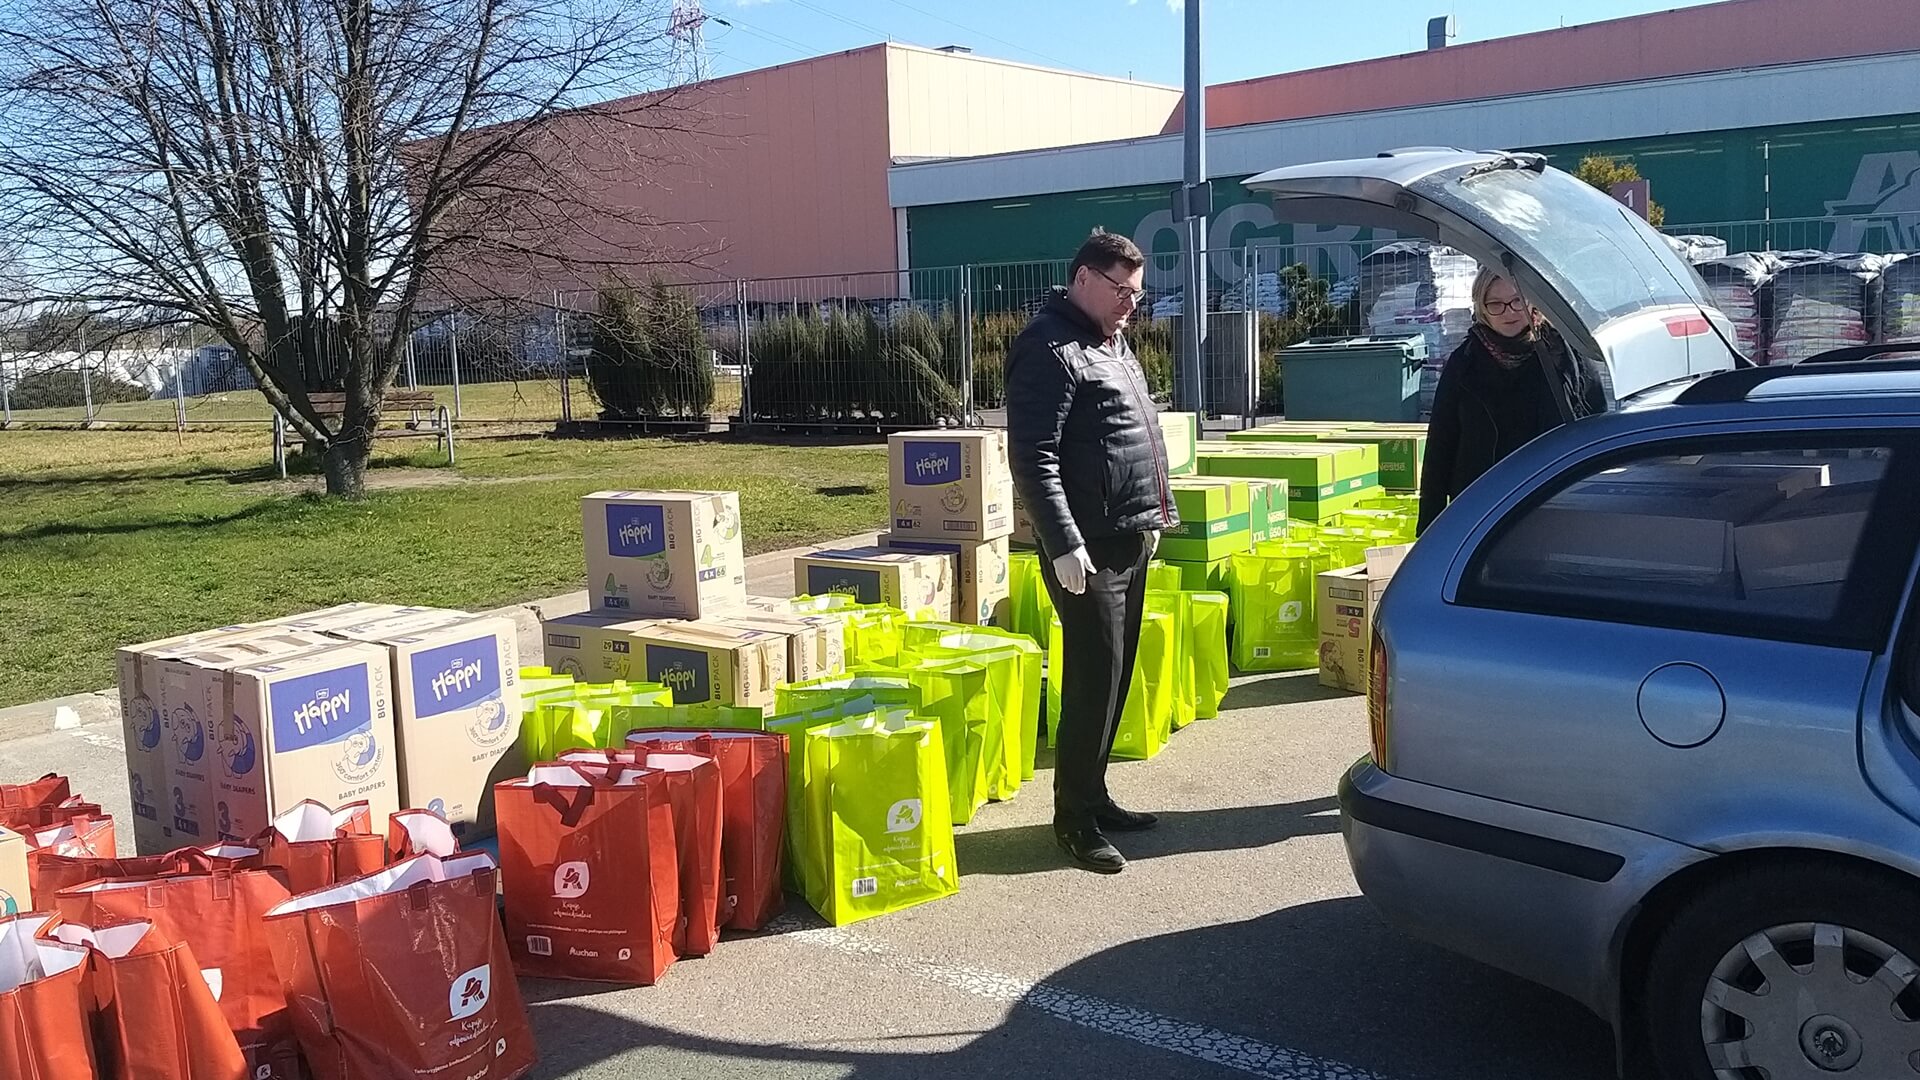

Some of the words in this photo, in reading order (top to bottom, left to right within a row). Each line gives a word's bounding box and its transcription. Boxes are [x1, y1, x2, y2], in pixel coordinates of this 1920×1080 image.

[1623, 188, 1634, 208] 1
[1133, 203, 1398, 291] OGR
[666, 507, 674, 533] PACK
[669, 534, 677, 550] BIG
[700, 543, 714, 568] 4
[605, 572, 619, 596] 4
[1347, 617, 1361, 638] 5
[502, 636, 511, 668] PACK
[712, 655, 720, 683] PACK
[374, 665, 385, 699] PACK
[713, 683, 721, 700] BIG
[377, 698, 386, 720] BIG
[208, 720, 216, 741] BIG
[471, 752, 489, 763] BABY
[132, 772, 145, 803] 3
[338, 789, 357, 800] BABY
[358, 780, 386, 794] DIAPERS
[173, 786, 186, 817] 3
[217, 801, 231, 833] 3
[569, 946, 599, 958] Auchan
